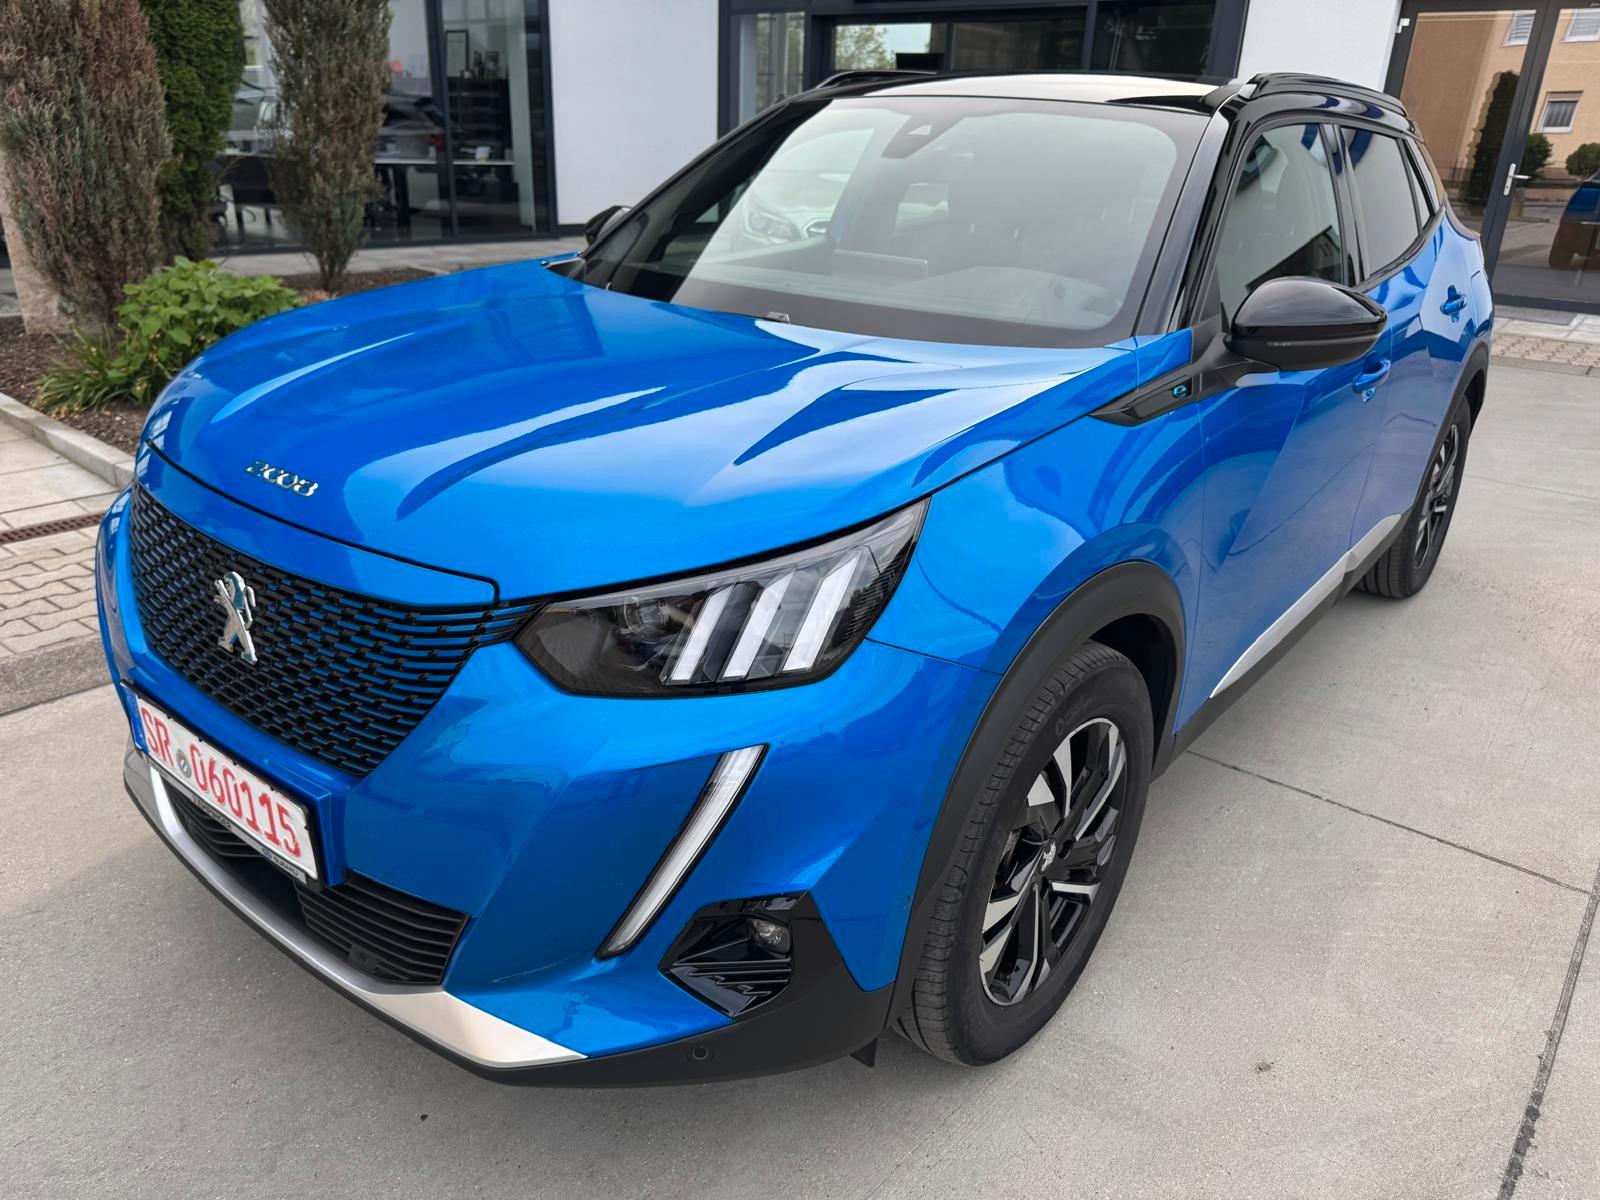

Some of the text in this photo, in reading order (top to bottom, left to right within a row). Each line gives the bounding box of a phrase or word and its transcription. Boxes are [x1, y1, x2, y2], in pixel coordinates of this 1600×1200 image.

[244, 461, 318, 496] 2008
[141, 707, 174, 767] SR
[190, 744, 300, 857] 060115
